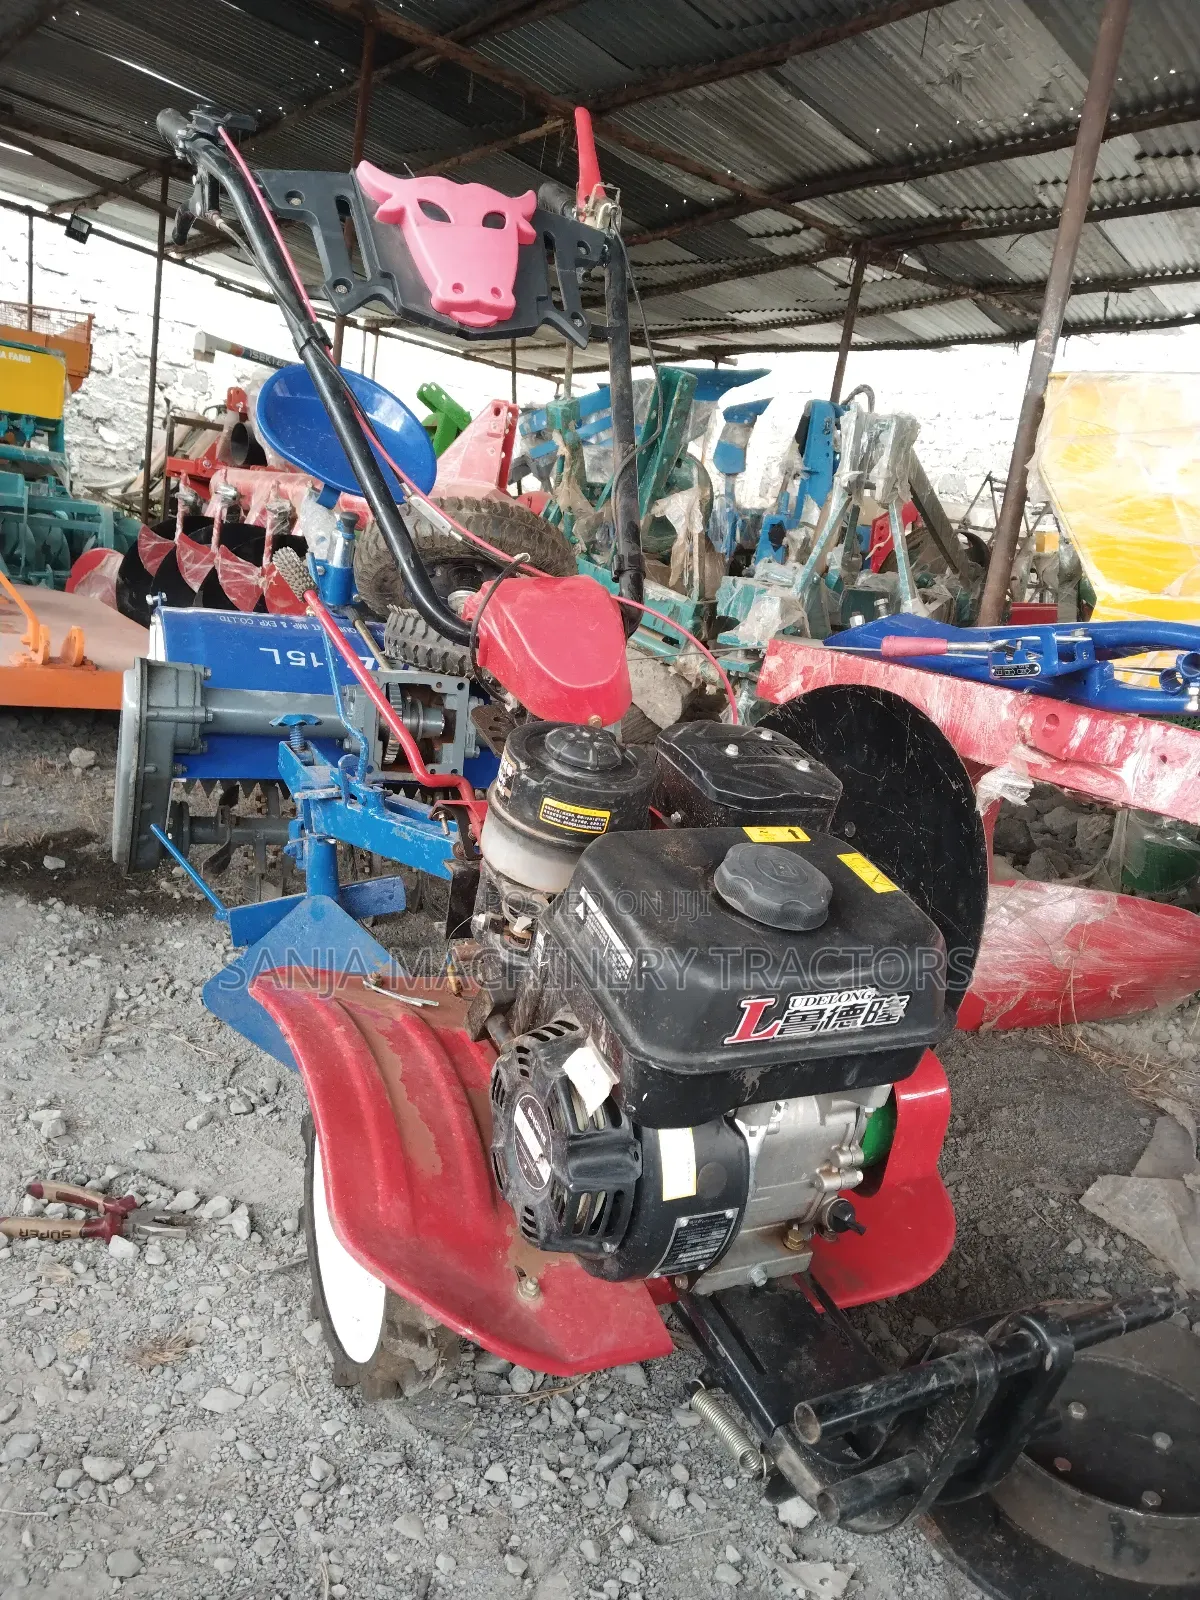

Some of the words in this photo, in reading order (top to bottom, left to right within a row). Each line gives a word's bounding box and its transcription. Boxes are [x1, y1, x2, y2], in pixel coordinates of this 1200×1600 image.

[8, 352, 31, 364] FARM
[248, 350, 275, 366] ISEKI
[18, 1228, 71, 1240] SUPER
